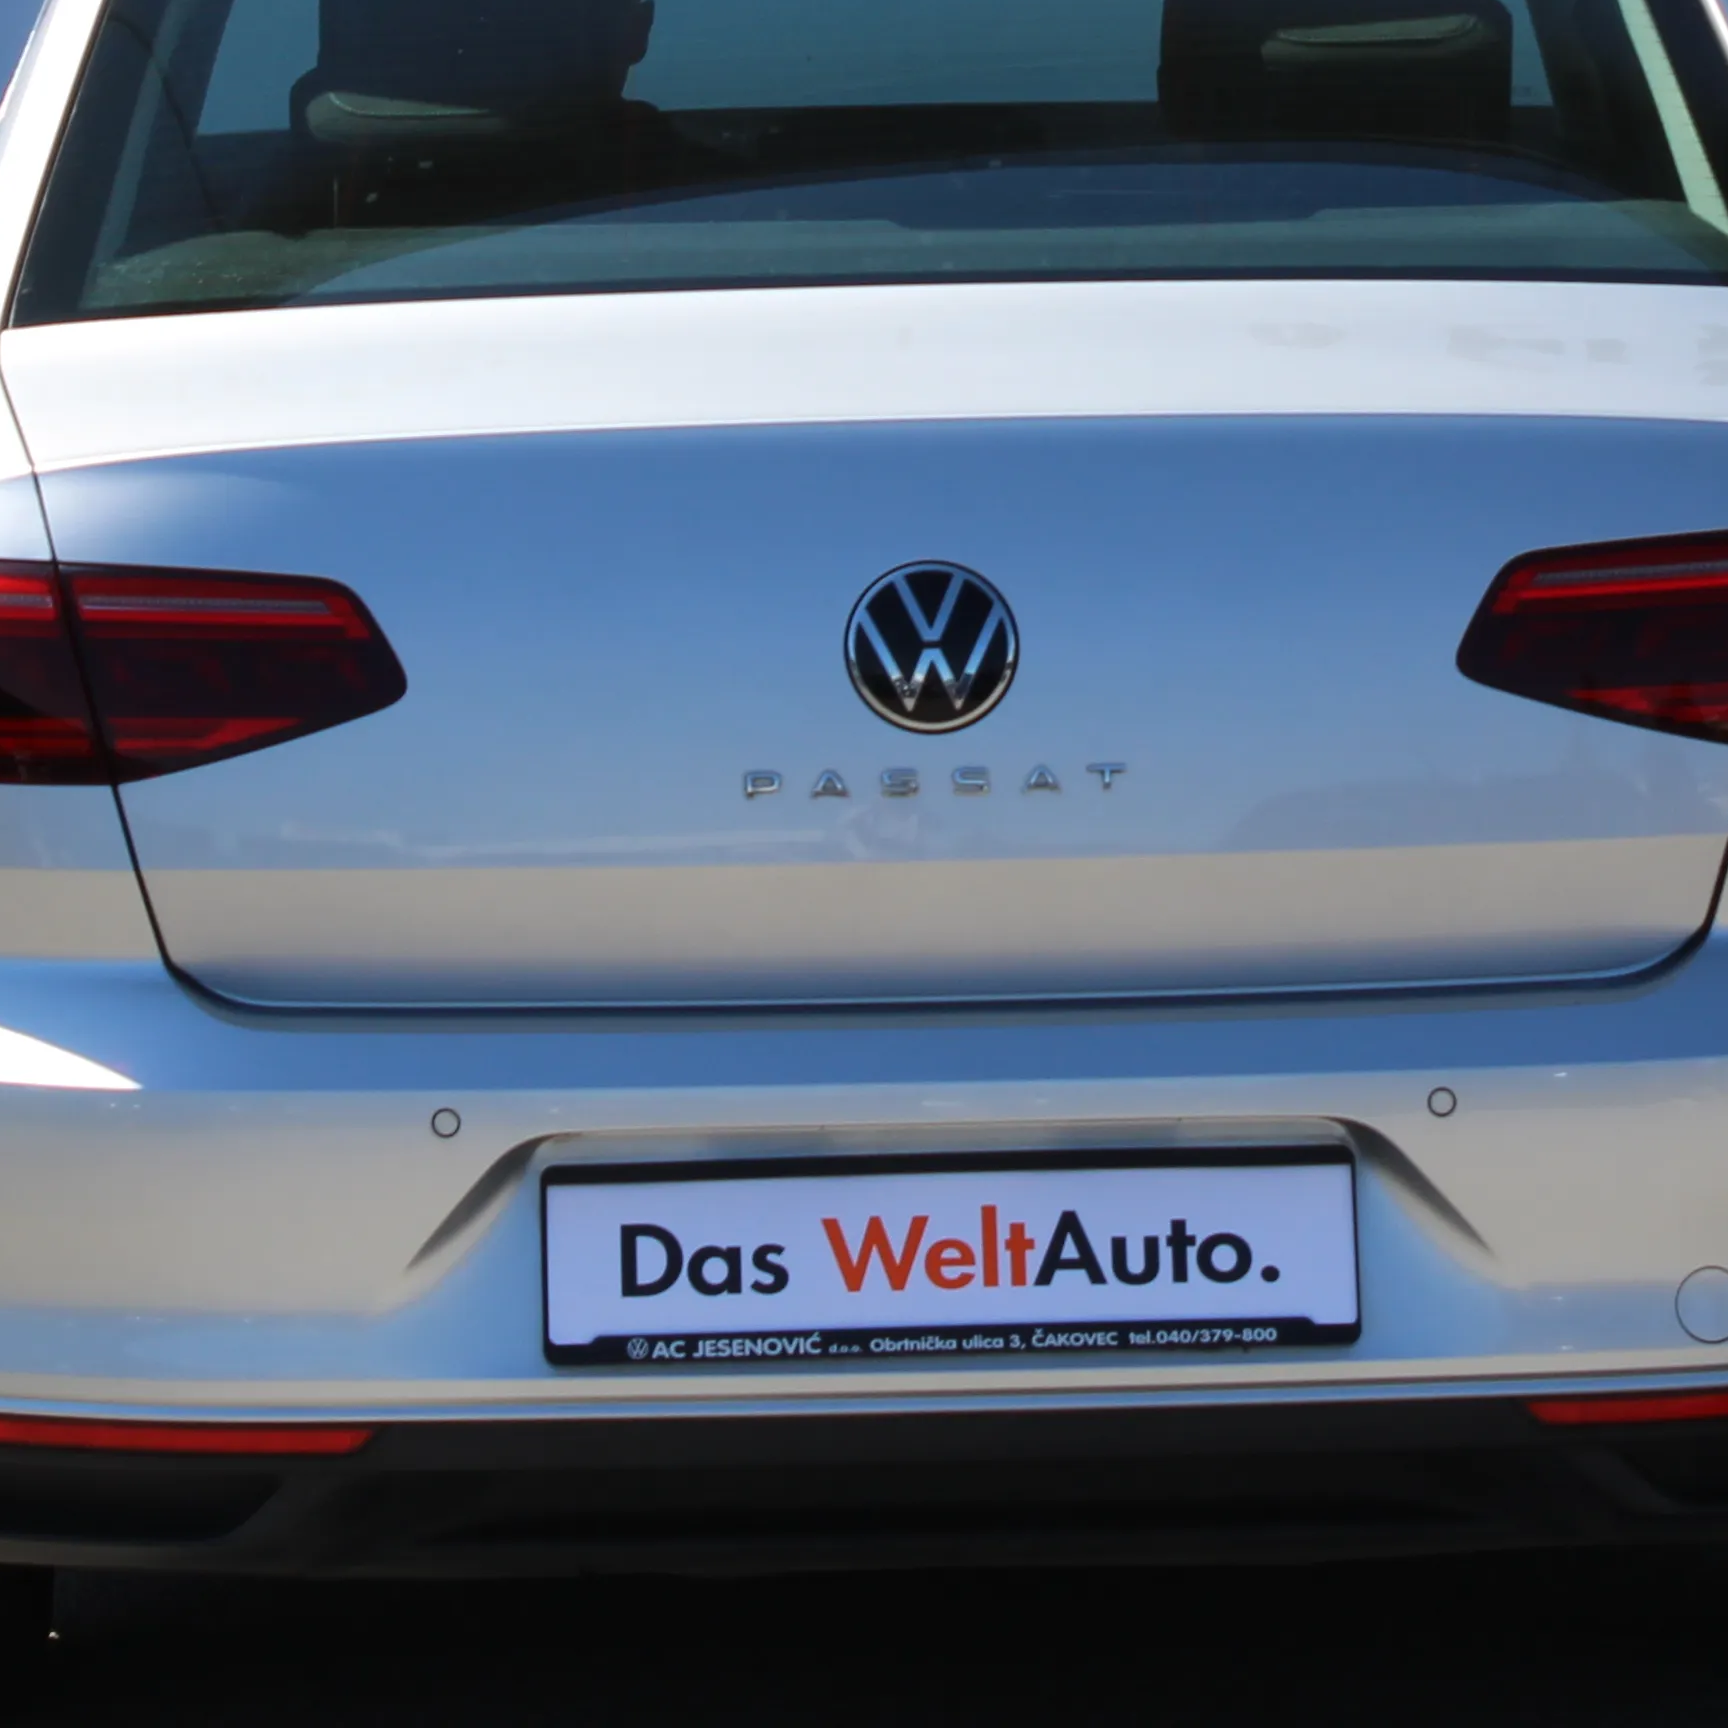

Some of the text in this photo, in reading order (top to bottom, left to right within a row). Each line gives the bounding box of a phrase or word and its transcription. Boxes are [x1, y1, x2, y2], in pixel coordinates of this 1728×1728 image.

[743, 762, 1128, 800] PASSAT
[620, 1204, 1280, 1298] Das WeltAuto.
[652, 1340, 686, 1359] AC
[692, 1332, 822, 1358] JESENOVIĆ
[962, 1334, 1004, 1350] ulica
[1009, 1334, 1027, 1350] 3,
[1031, 1328, 1119, 1349] ČAKOVEC
